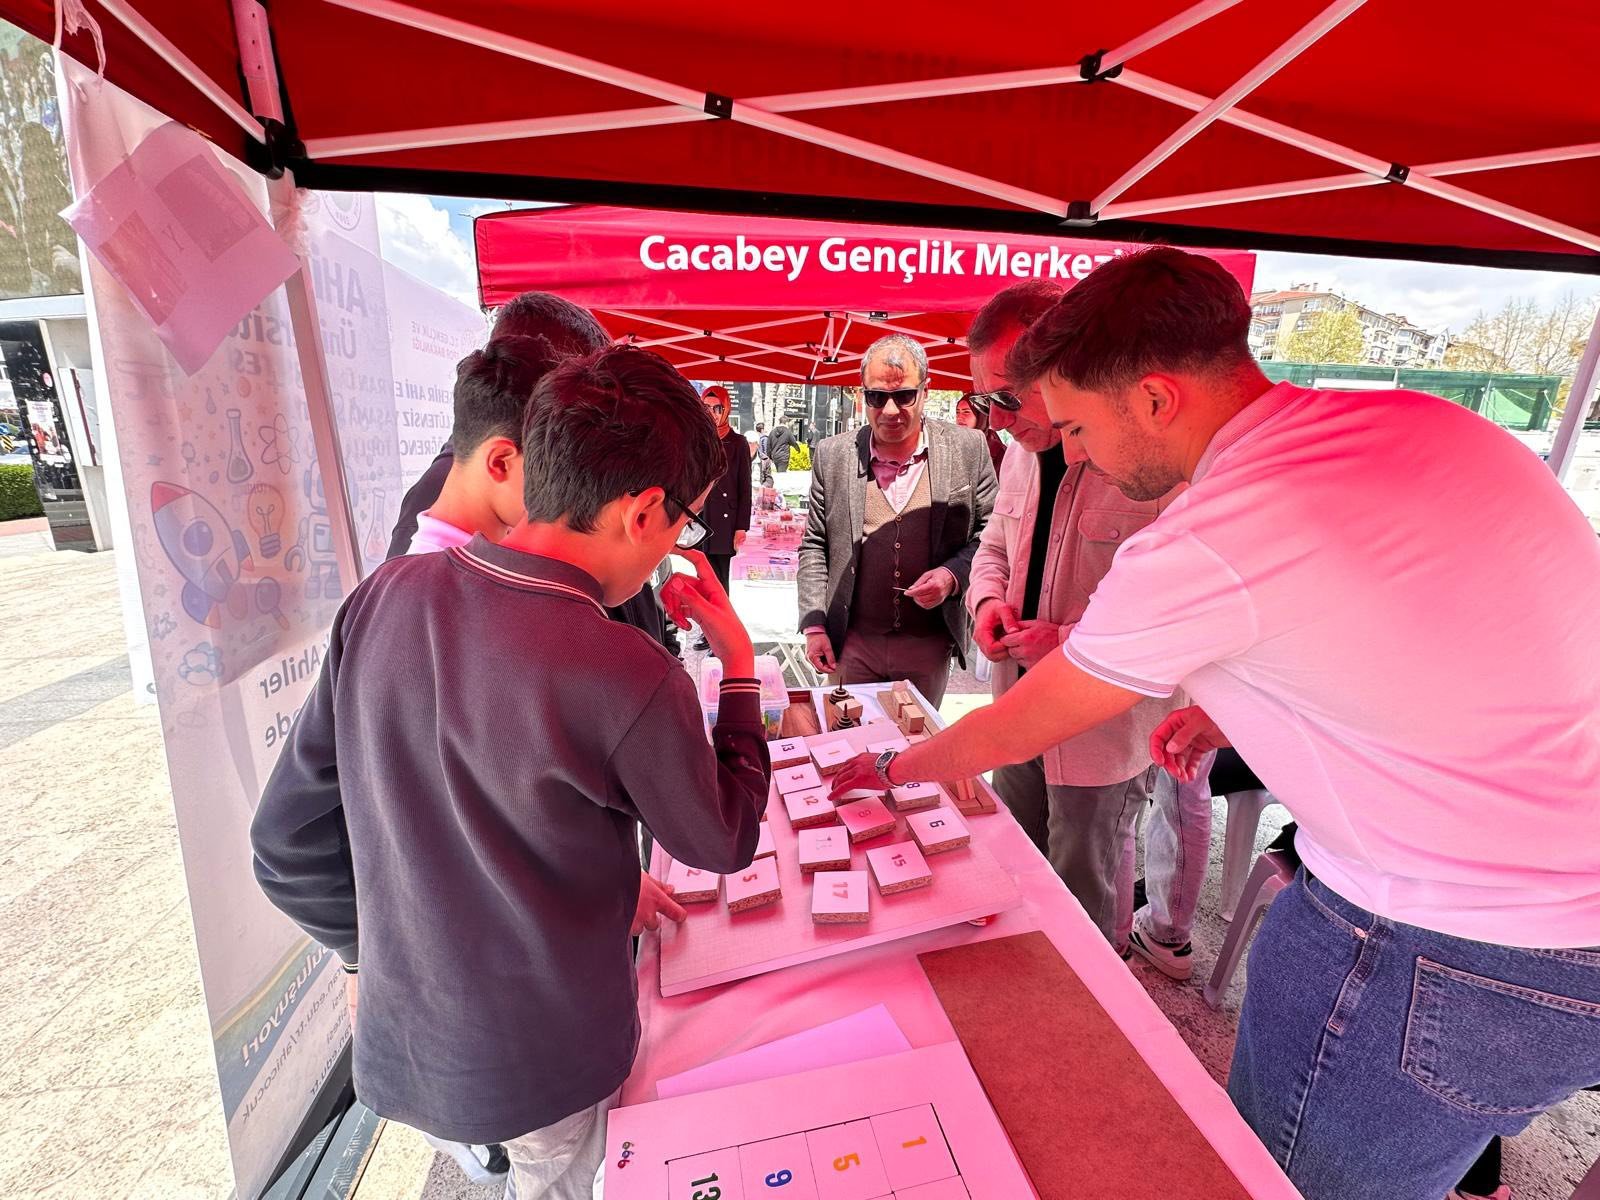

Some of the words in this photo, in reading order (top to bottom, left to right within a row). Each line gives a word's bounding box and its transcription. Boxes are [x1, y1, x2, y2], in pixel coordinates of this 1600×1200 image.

[638, 235, 810, 282] Cacabey
[818, 238, 965, 283] Gençlik
[781, 743, 796, 752] 13
[803, 795, 819, 806] 12
[929, 819, 945, 828] 6
[890, 853, 906, 867] 15
[742, 873, 758, 883] 5
[831, 881, 849, 900] 17
[901, 1135, 928, 1149] 1
[832, 1152, 861, 1172] 5
[764, 1168, 793, 1188] 9
[690, 1172, 722, 1200] 13
